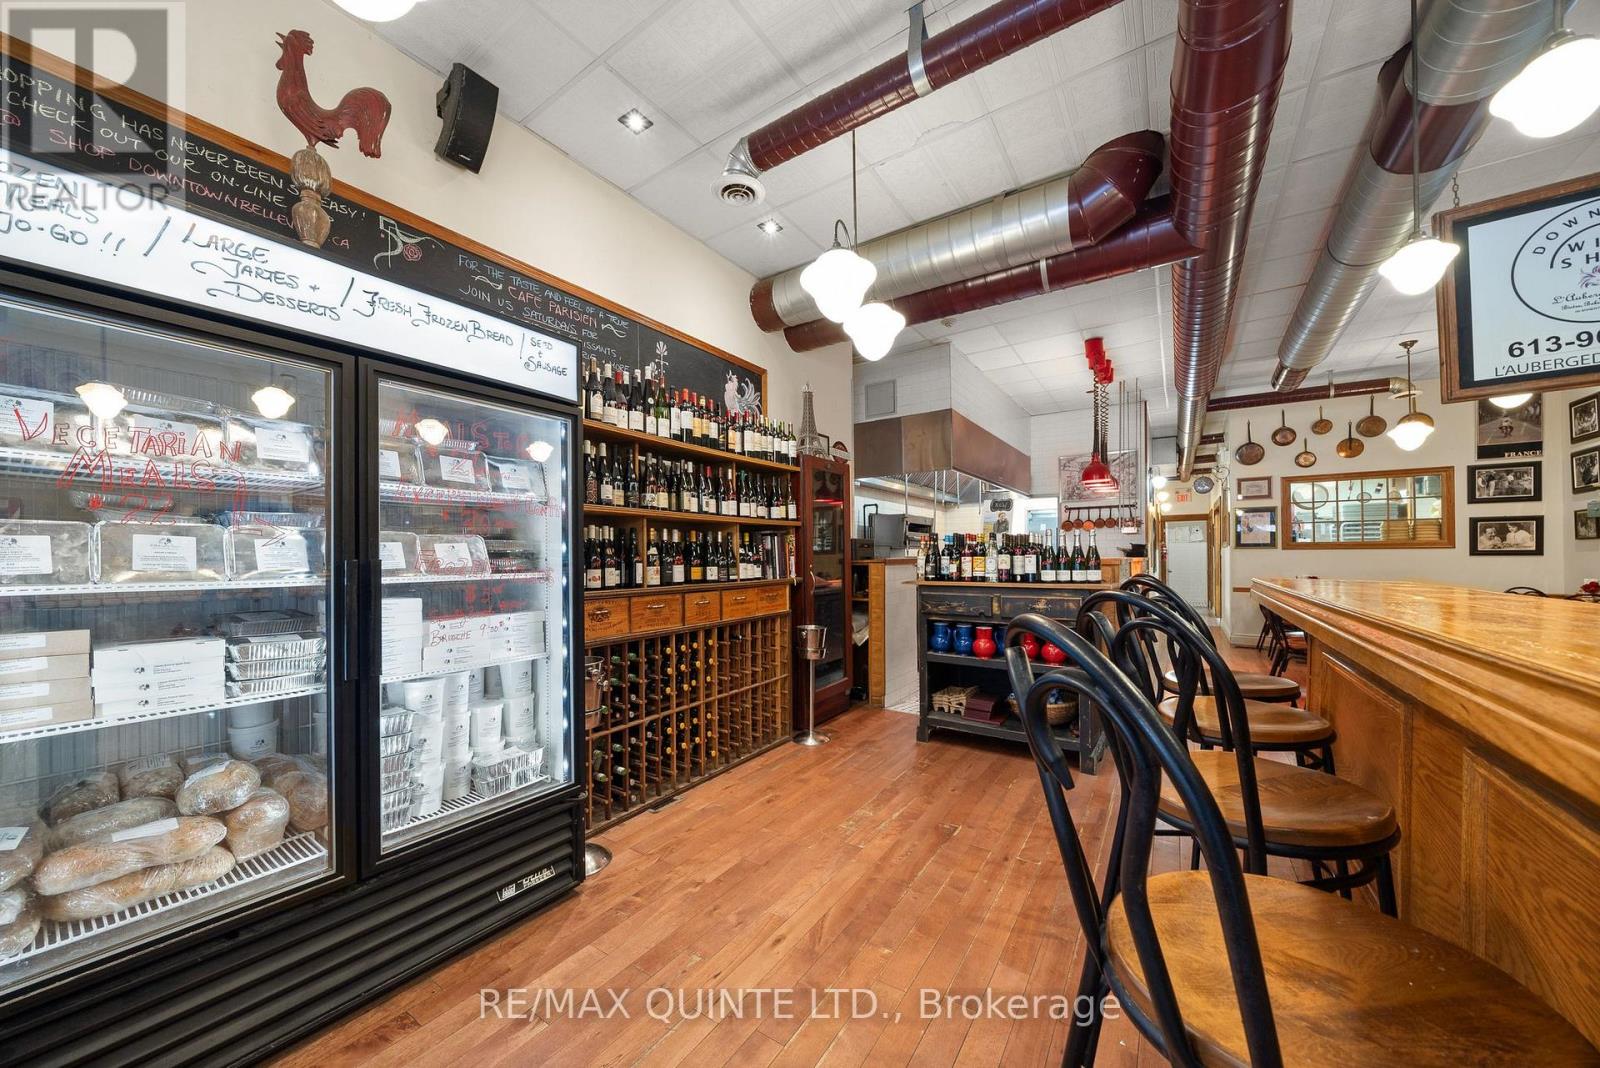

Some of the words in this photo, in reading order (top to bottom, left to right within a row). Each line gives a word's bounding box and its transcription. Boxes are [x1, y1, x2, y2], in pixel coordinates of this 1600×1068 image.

[0, 66, 107, 122] OPPING
[121, 114, 164, 141] HAS
[171, 136, 230, 168] NEVER
[233, 158, 283, 188] BEEN
[6, 91, 91, 133] CHECK
[100, 128, 144, 150] OUT
[155, 149, 201, 174] OUR
[50, 128, 116, 160] SHOP
[182, 222, 270, 263] LARGE
[206, 280, 341, 322] DESSERTS
[459, 254, 481, 273] FOR
[484, 264, 505, 281] THE
[512, 275, 541, 295] TASTE
[544, 289, 562, 302] AND
[564, 295, 582, 311] FEEL
[585, 304, 596, 314] OF
[459, 284, 491, 303] JOIN
[498, 299, 514, 312] US
[581, 328, 598, 340] FOR
[549, 301, 597, 329] PARISIEN
[1504, 448, 1544, 459] FRANCE
